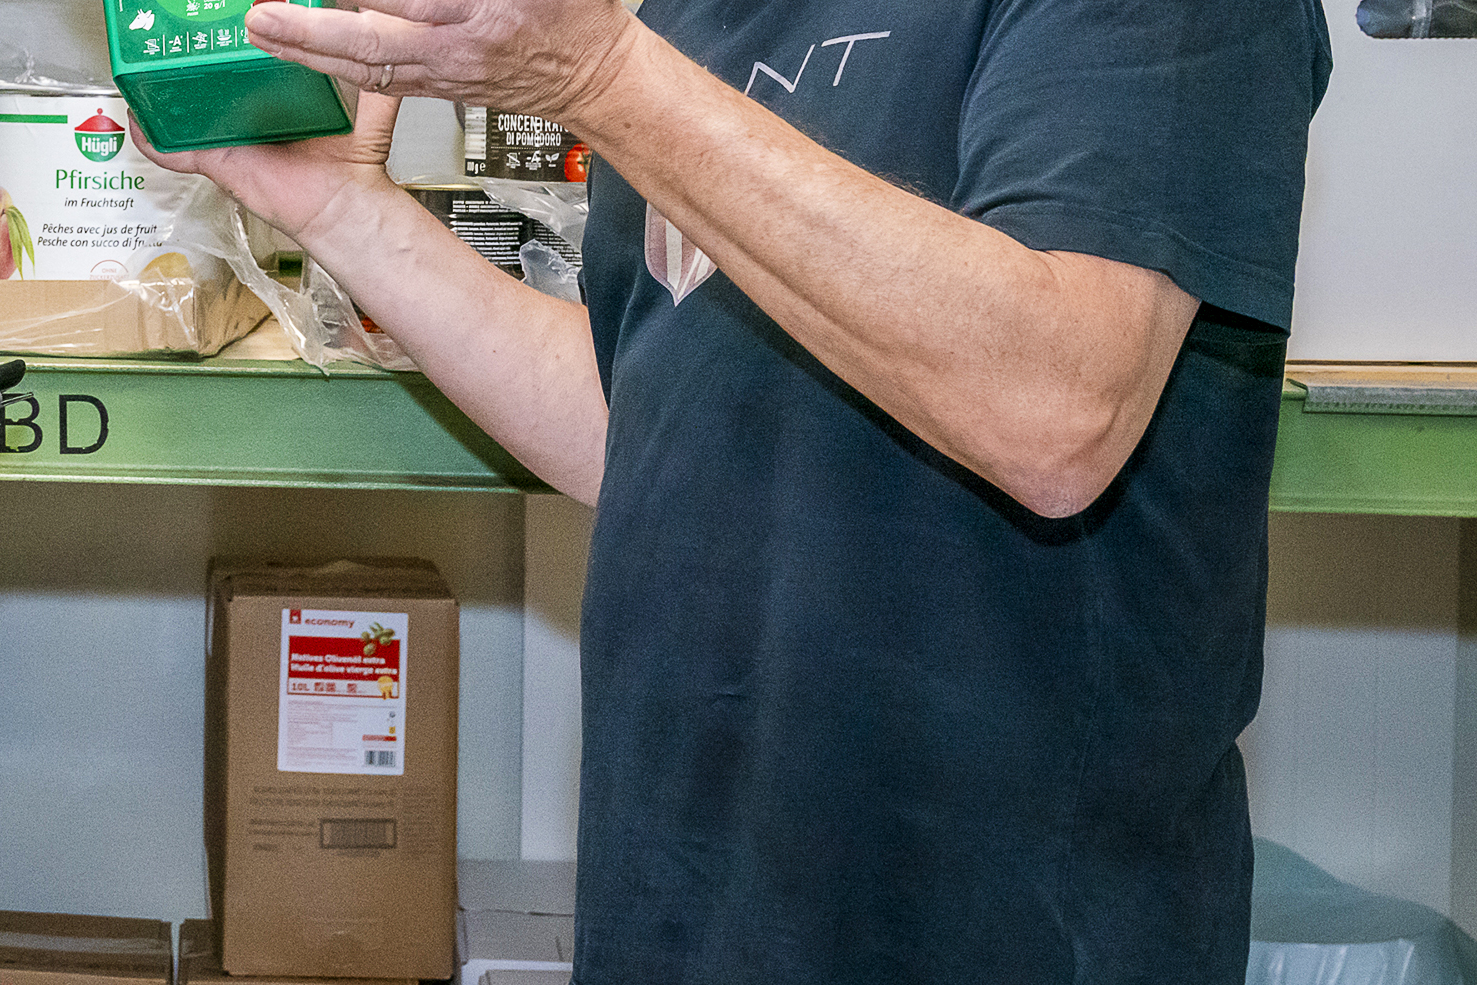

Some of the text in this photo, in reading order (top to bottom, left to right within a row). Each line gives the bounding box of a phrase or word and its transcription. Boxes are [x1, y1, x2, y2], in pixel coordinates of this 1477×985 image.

[214, 0, 225, 10] g/l
[506, 132, 561, 146] DI POMODORO
[81, 136, 117, 156] Hügli
[56, 169, 145, 190] Pfirsiche
[64, 197, 134, 210] im Fruchtsaft
[42, 223, 74, 234] Pêches
[101, 225, 117, 237] jus
[121, 225, 133, 234] de
[134, 224, 157, 236] fruit
[37, 236, 67, 247] Pesche
[70, 239, 89, 247] con
[91, 239, 119, 247] succo
[122, 238, 132, 247] di
[305, 619, 355, 628] economy
